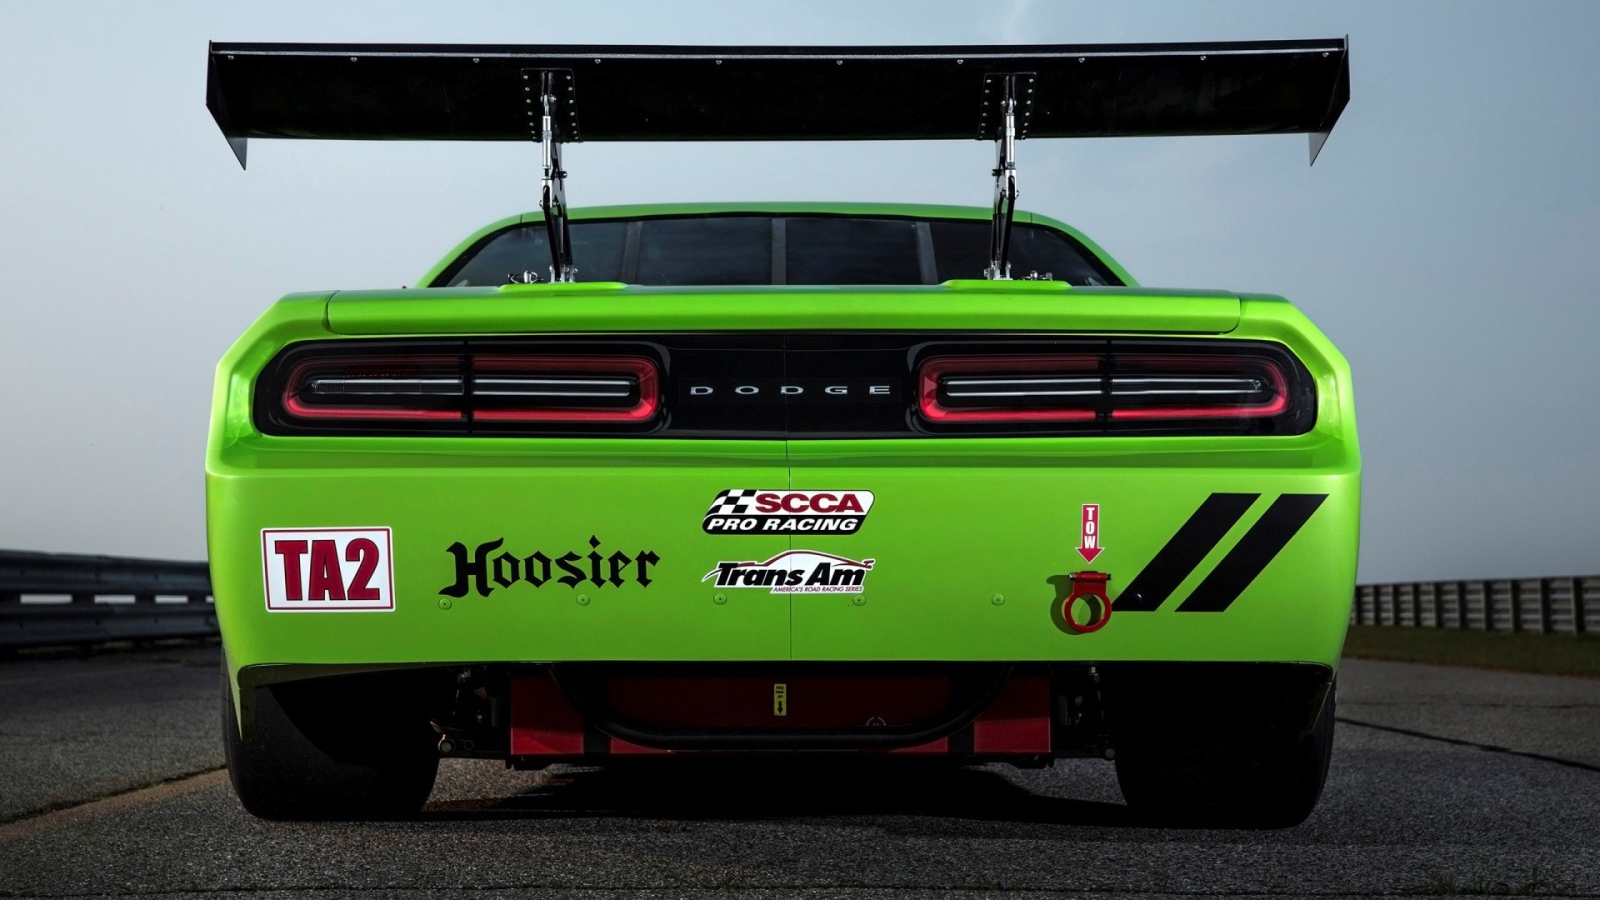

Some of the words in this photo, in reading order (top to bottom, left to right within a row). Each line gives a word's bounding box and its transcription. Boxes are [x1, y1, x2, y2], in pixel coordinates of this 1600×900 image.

[690, 386, 891, 396] DODGE
[755, 493, 865, 513] SCCA
[706, 518, 758, 531] PRO
[762, 518, 859, 531] RACING
[1084, 507, 1096, 549] TOW
[274, 537, 381, 601] TA2
[438, 535, 661, 598] Hoosier
[716, 562, 806, 586] Trans
[804, 562, 866, 586] Am
